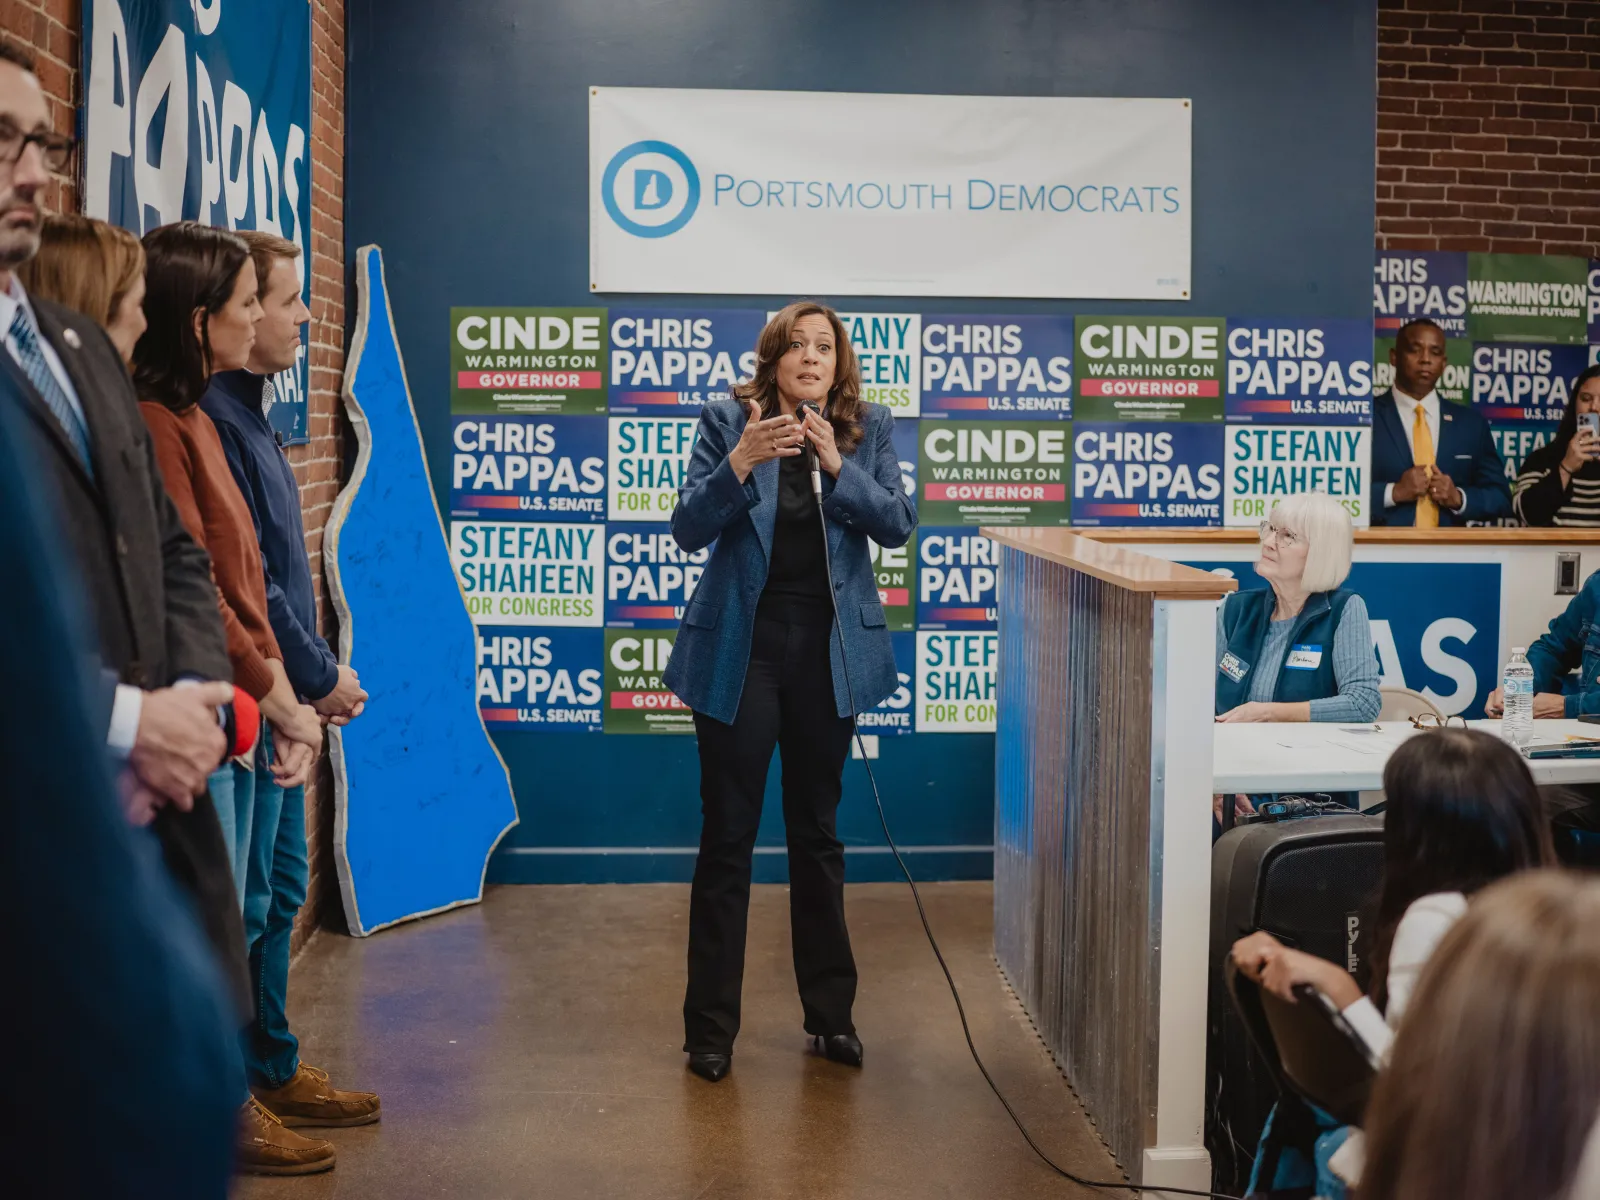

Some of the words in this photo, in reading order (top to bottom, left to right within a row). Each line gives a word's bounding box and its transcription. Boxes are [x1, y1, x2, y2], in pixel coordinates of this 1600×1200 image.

[714, 174, 951, 210] PORTSMOUTH
[968, 179, 1179, 213] DEMOCRATS
[1467, 281, 1586, 307] WARMINGTON
[1471, 305, 1538, 316] AFFORDABLE
[1540, 305, 1580, 317] FUTURE
[456, 316, 600, 350] CINDE
[611, 317, 713, 349] CHRIS
[922, 324, 1022, 354] CHRIS
[1080, 324, 1219, 360] CINDE
[1228, 328, 1324, 359] CHRIS
[466, 355, 596, 368] WARMINGTON
[611, 350, 757, 387] PAPPAS
[1088, 363, 1214, 377] WARMINGTON
[1473, 347, 1552, 374] CHRIS
[479, 374, 580, 387] GOVERNOR
[923, 357, 1071, 393] PAPPAS
[1228, 360, 1371, 397] PAPPAS
[677, 391, 705, 405] U.S.
[1101, 381, 1199, 395] GOVERNOR
[1472, 373, 1577, 405] PAPPA
[988, 397, 1014, 410] U.S.
[1017, 397, 1070, 411] SENATE
[1291, 400, 1317, 413] U.S.
[1318, 400, 1370, 414] SENATE
[1524, 408, 1545, 420] U.S.
[453, 421, 555, 453] CHRIS
[924, 429, 1065, 463] CINDE
[1075, 431, 1173, 462] CHRIS
[1233, 429, 1362, 461] STEFANY
[453, 454, 605, 494] PAPPAS
[932, 468, 1060, 481] WARMINGTON
[1075, 464, 1221, 500] PAPPAS
[617, 492, 651, 511] FOR
[946, 485, 1044, 499] GOVERNOR
[519, 496, 547, 510] U.S.
[549, 497, 603, 512] SENATE
[1139, 504, 1167, 517] U.S.
[1168, 504, 1219, 518] SENATE
[1233, 499, 1265, 517] FOR
[460, 525, 595, 560] STEFANY
[460, 562, 594, 595] SHAHEEN
[467, 596, 492, 614] OR
[500, 597, 594, 617] CONGRESS
[1220, 657, 1246, 678] PAPPAS
[632, 695, 687, 708] GOVE
[517, 708, 545, 722] U.S.
[547, 709, 601, 723] SENATE
[857, 712, 910, 726] SENATE
[925, 704, 958, 722] FOR
